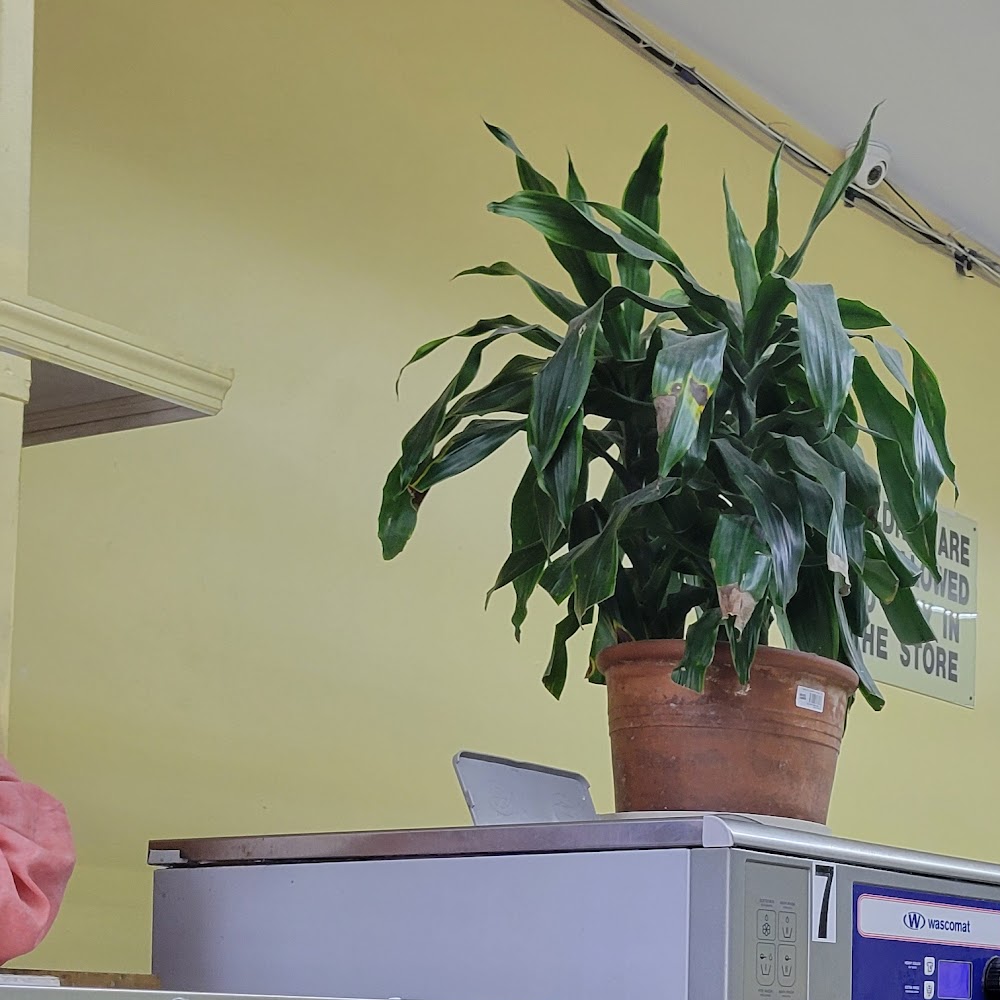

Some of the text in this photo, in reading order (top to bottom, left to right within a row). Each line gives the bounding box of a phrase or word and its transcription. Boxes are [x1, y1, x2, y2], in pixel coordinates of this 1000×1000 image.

[938, 526, 970, 567] ARE
[943, 612, 960, 643] IN
[856, 624, 959, 683] HE STORE
[815, 864, 834, 938] 7
[928, 918, 971, 933] wascomat
